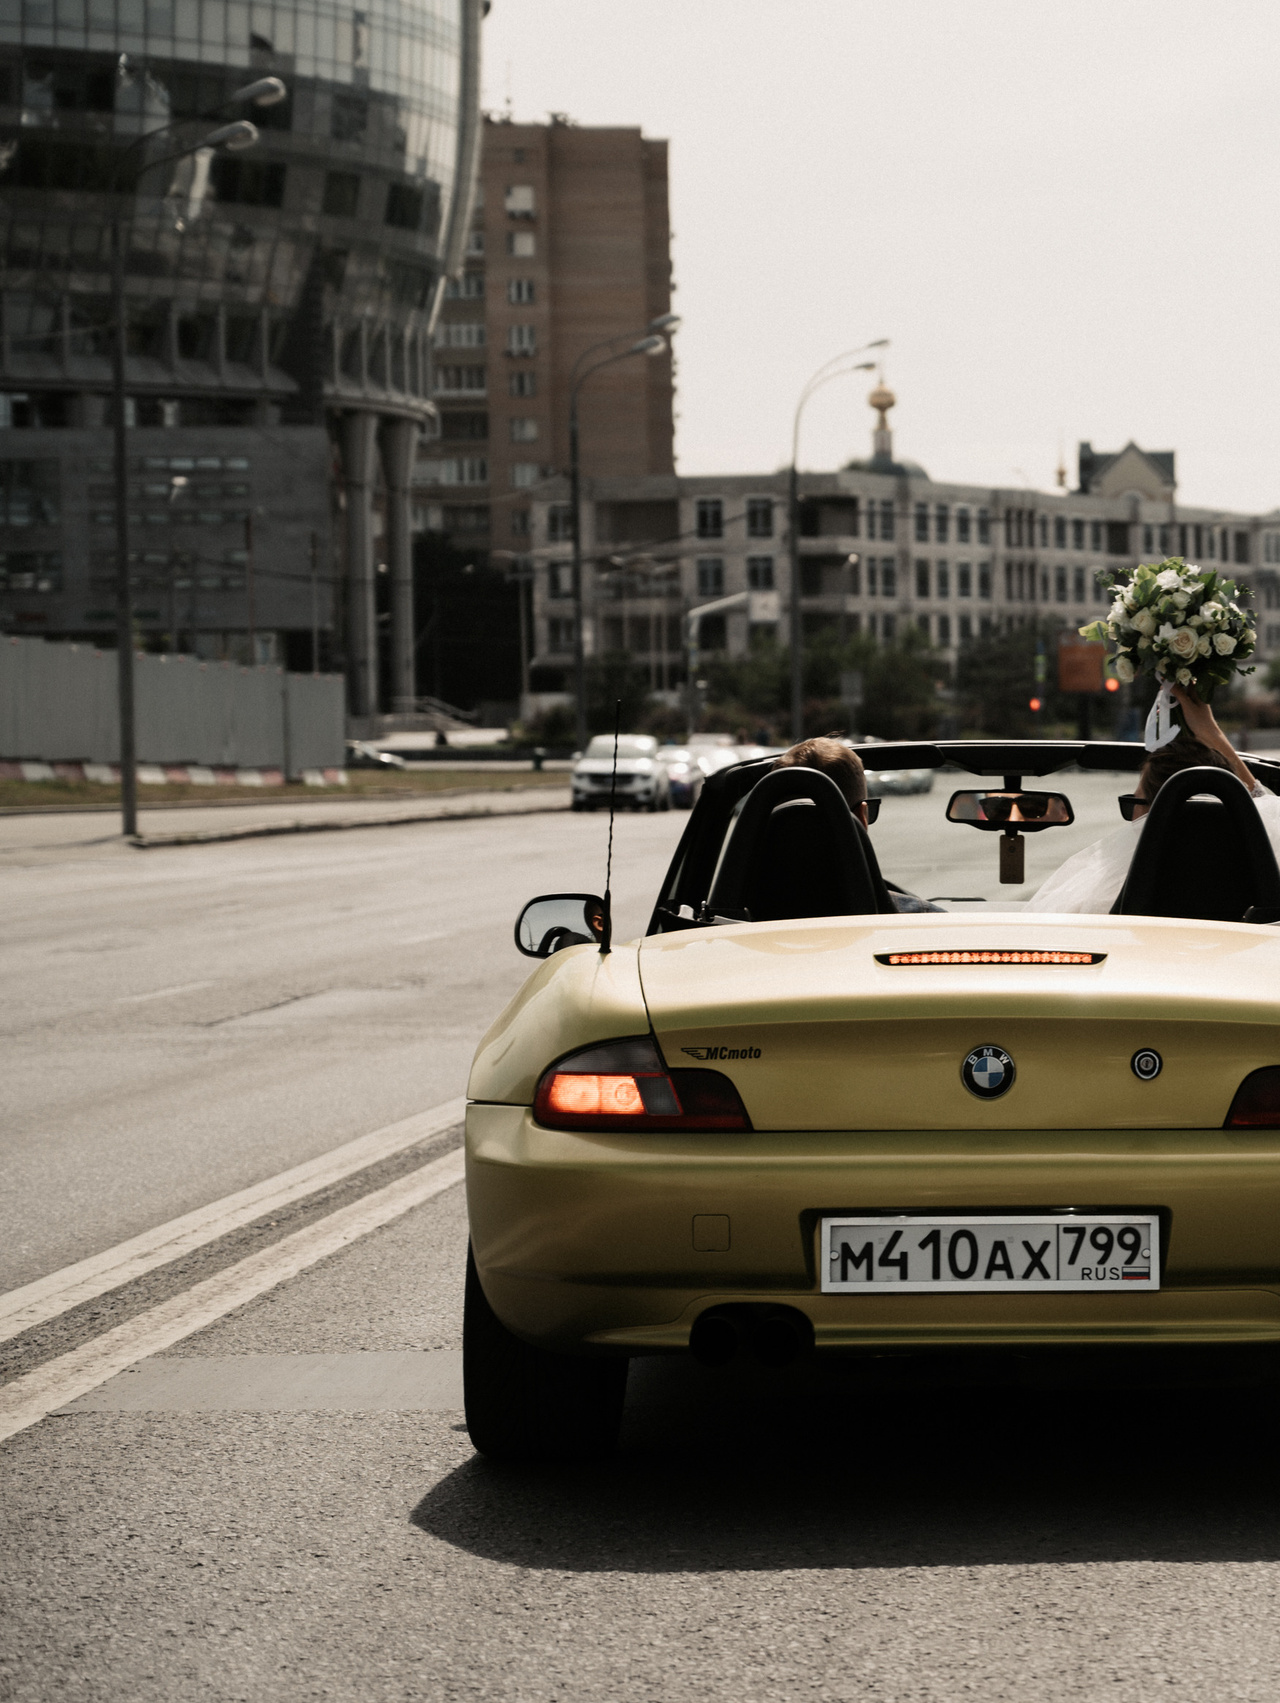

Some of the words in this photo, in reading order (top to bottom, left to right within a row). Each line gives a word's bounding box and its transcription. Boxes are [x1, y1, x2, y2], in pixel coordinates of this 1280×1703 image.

[706, 1046, 762, 1060] MCmoto
[967, 1048, 1010, 1065] BMW
[1062, 1226, 1142, 1265] 799
[1081, 1267, 1120, 1281] RUS
